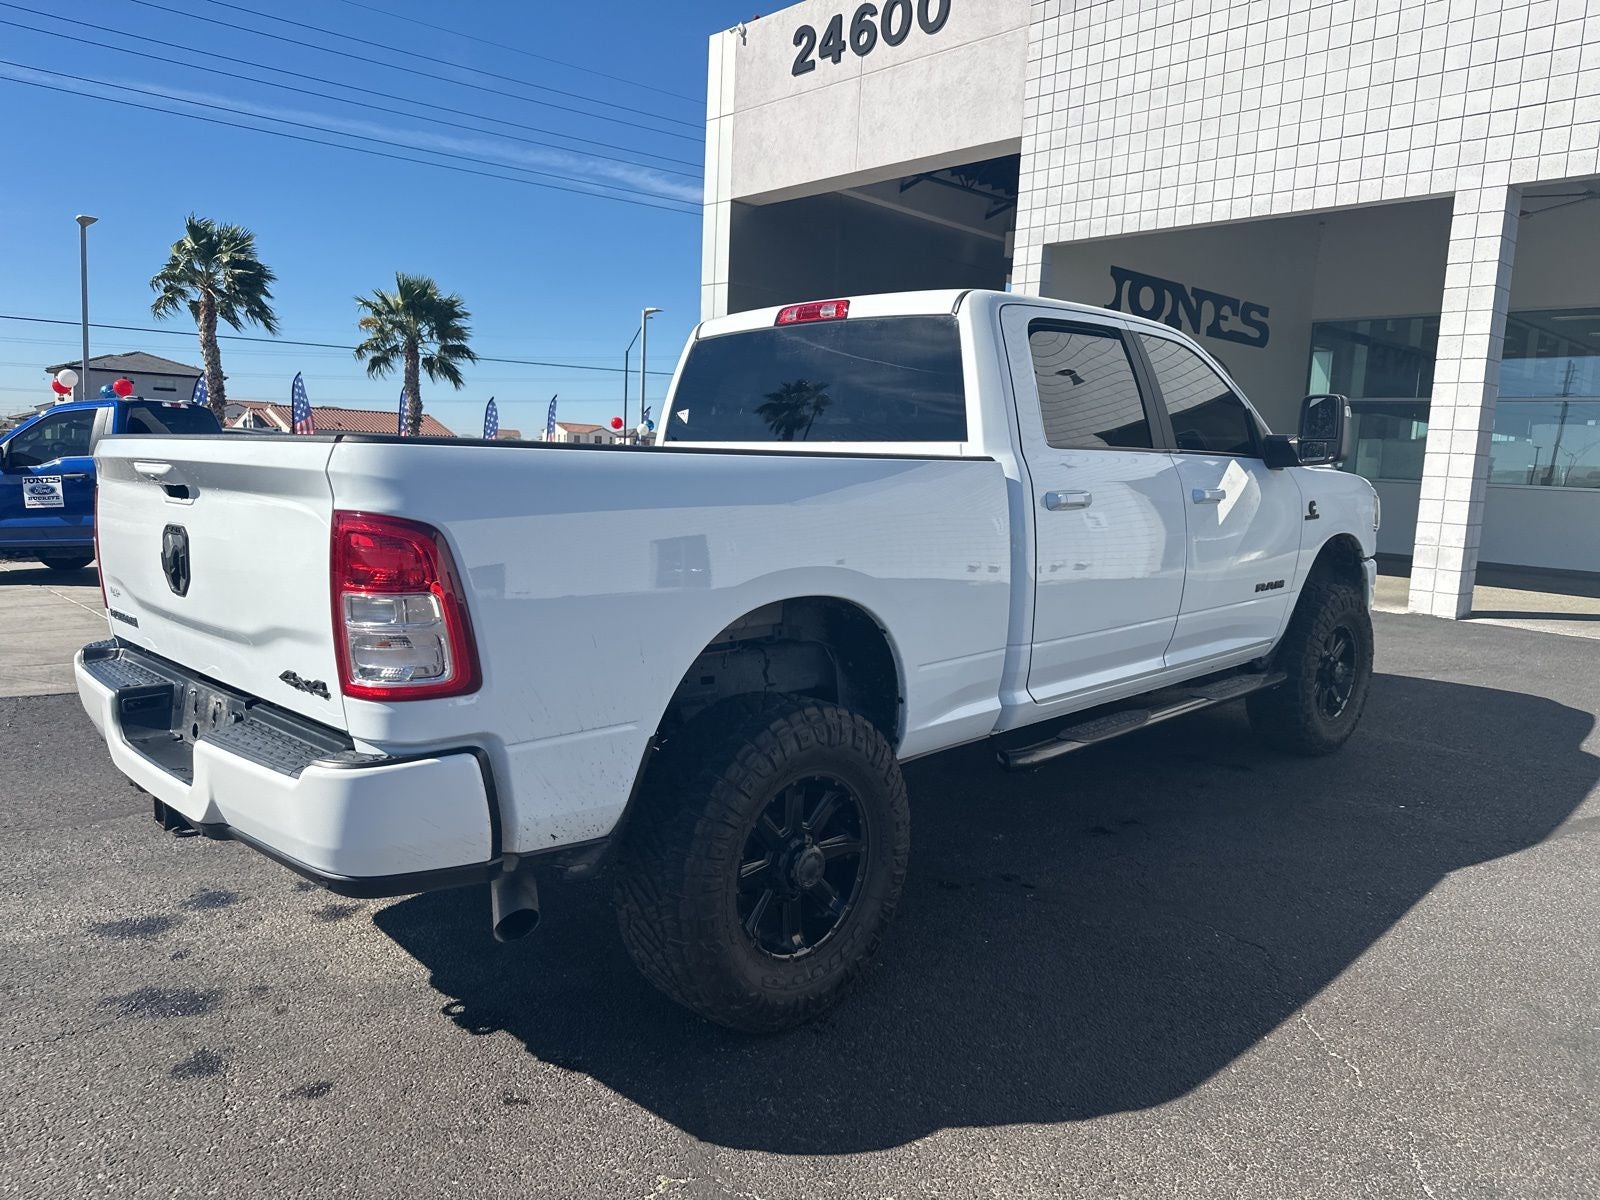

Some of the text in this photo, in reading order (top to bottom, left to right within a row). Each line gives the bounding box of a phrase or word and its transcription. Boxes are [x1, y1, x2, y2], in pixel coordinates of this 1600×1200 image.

[791, 0, 952, 77] 24600
[1104, 265, 1270, 348] JONES
[34, 486, 51, 494] Ford
[1254, 580, 1285, 593] RAM
